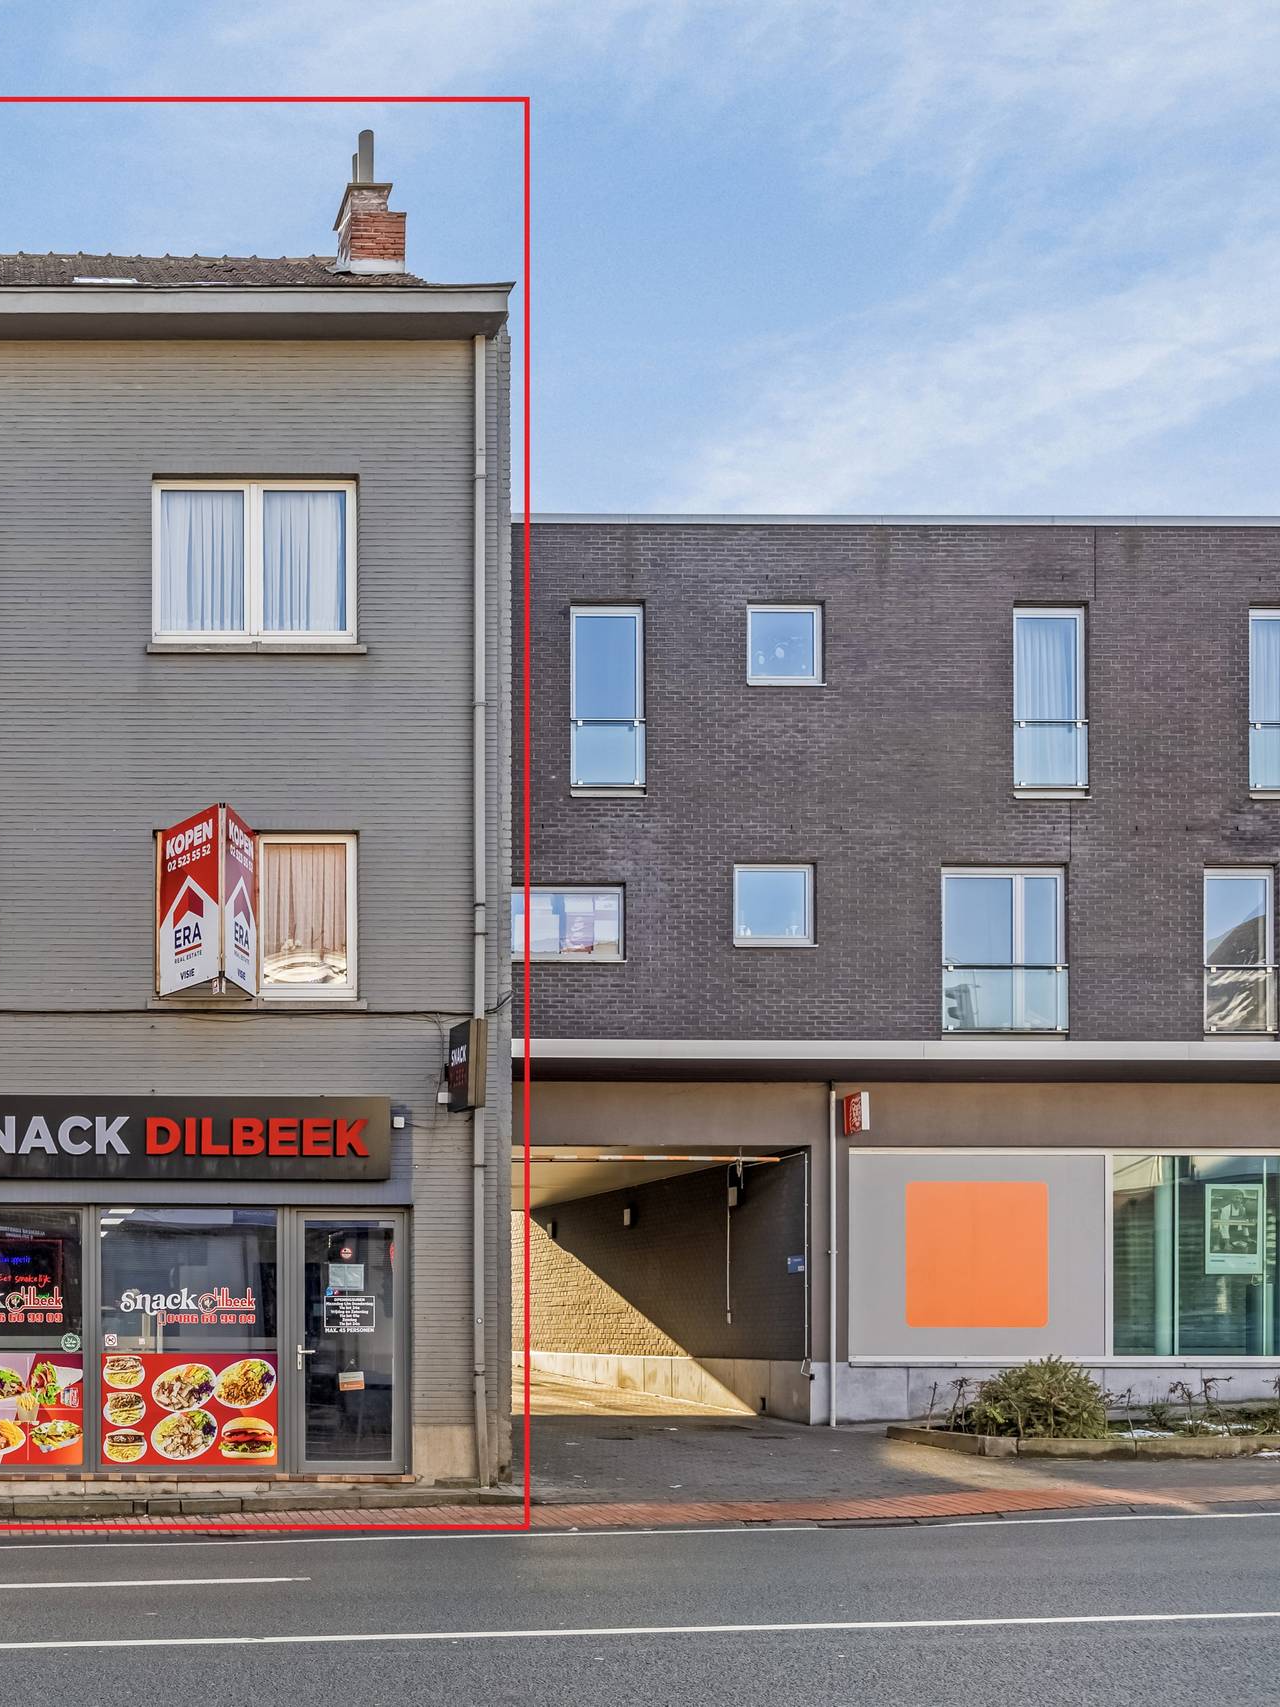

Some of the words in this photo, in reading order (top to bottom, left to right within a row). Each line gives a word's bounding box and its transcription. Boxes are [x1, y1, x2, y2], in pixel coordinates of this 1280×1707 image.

[166, 818, 213, 860] KOPEN
[228, 819, 254, 861] KOPEN
[167, 860, 177, 872] 02
[177, 853, 191, 868] 523
[191, 848, 201, 861] 55
[201, 844, 211, 857] 52
[174, 922, 202, 949] ERA
[234, 921, 250, 950] ERA
[174, 955, 186, 964] REAL
[186, 950, 202, 960] ESTATE
[180, 968, 195, 980] VISIE
[145, 1117, 370, 1157] DILBEEK
